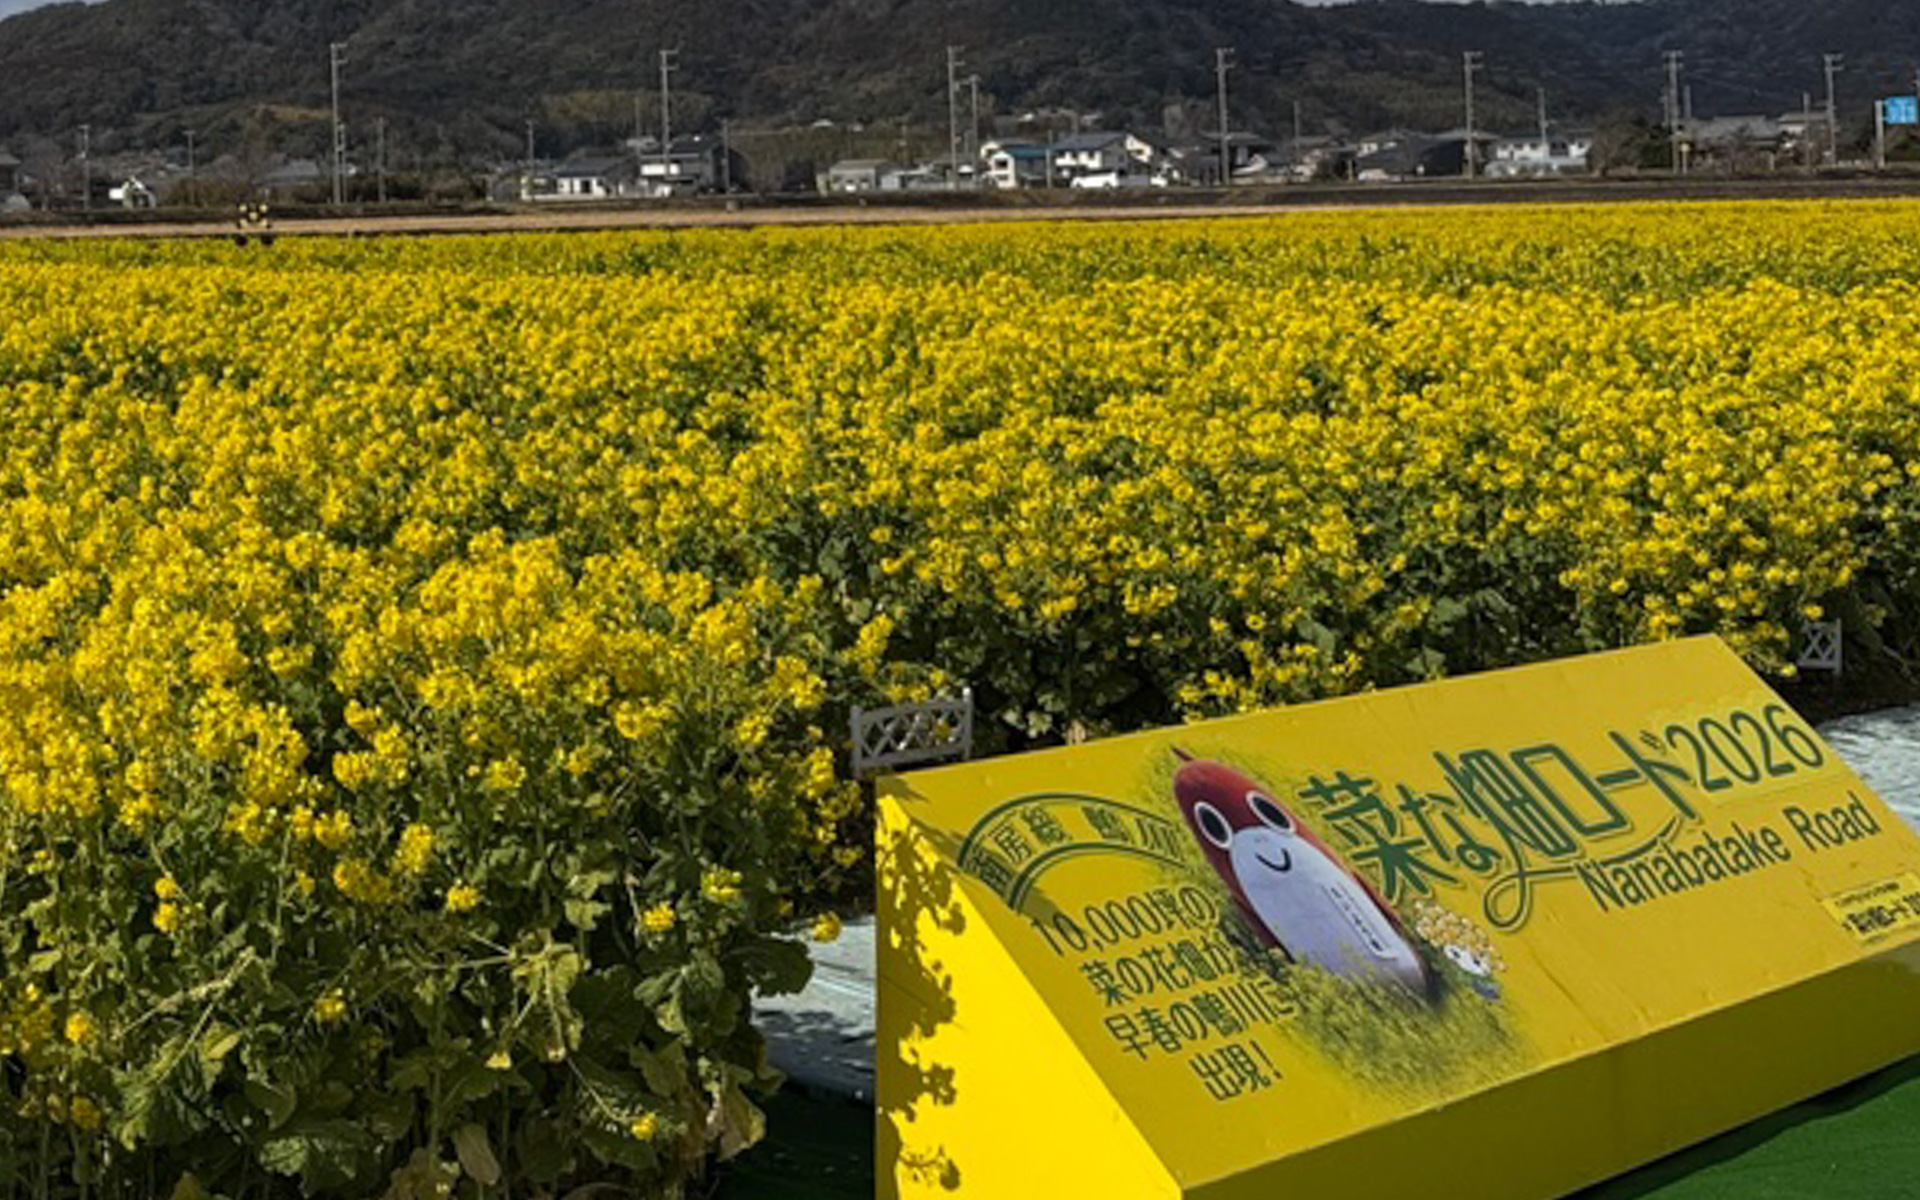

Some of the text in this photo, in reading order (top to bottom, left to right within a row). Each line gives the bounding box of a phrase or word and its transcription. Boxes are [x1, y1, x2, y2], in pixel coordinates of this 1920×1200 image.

[1576, 790, 1882, 912] Nanabatake Road
[1032, 887, 1216, 957] 10,000坪の
[1081, 934, 1236, 1007] 菜の花畑が
[1104, 981, 1295, 1060] 早春の鴨川に
